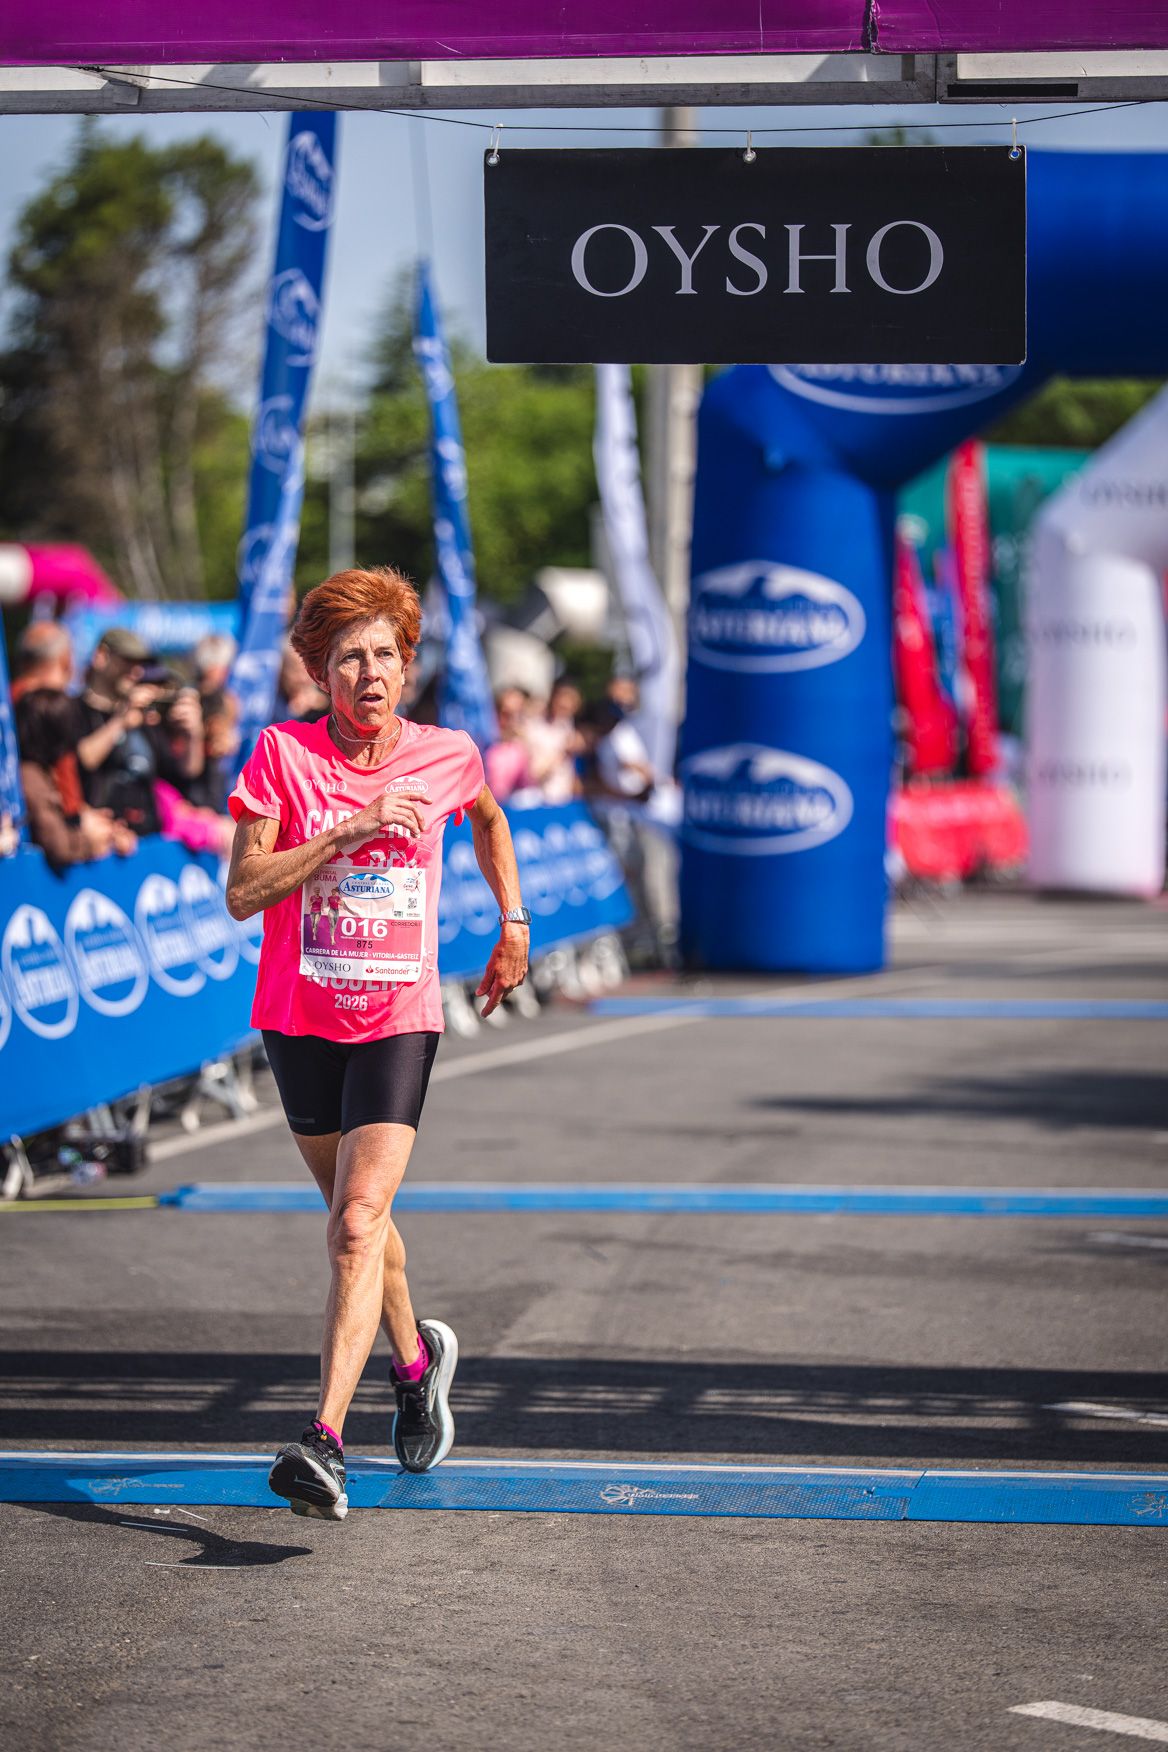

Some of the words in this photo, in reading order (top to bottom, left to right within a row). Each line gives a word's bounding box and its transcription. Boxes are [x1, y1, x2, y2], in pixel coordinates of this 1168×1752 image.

[570, 220, 945, 297] OYSHO
[302, 779, 347, 793] OYSHO
[389, 784, 425, 793] ASTURIANA
[343, 881, 390, 894] ASTURIANA
[341, 917, 388, 938] 016
[356, 940, 373, 949] 875
[305, 947, 330, 956] CARRERA
[348, 950, 369, 958] MUJER
[372, 952, 419, 960] VITORIA-GASTEIZ
[314, 960, 351, 973] OYSHO
[375, 967, 410, 975] Santander
[334, 994, 368, 1012] 2026
